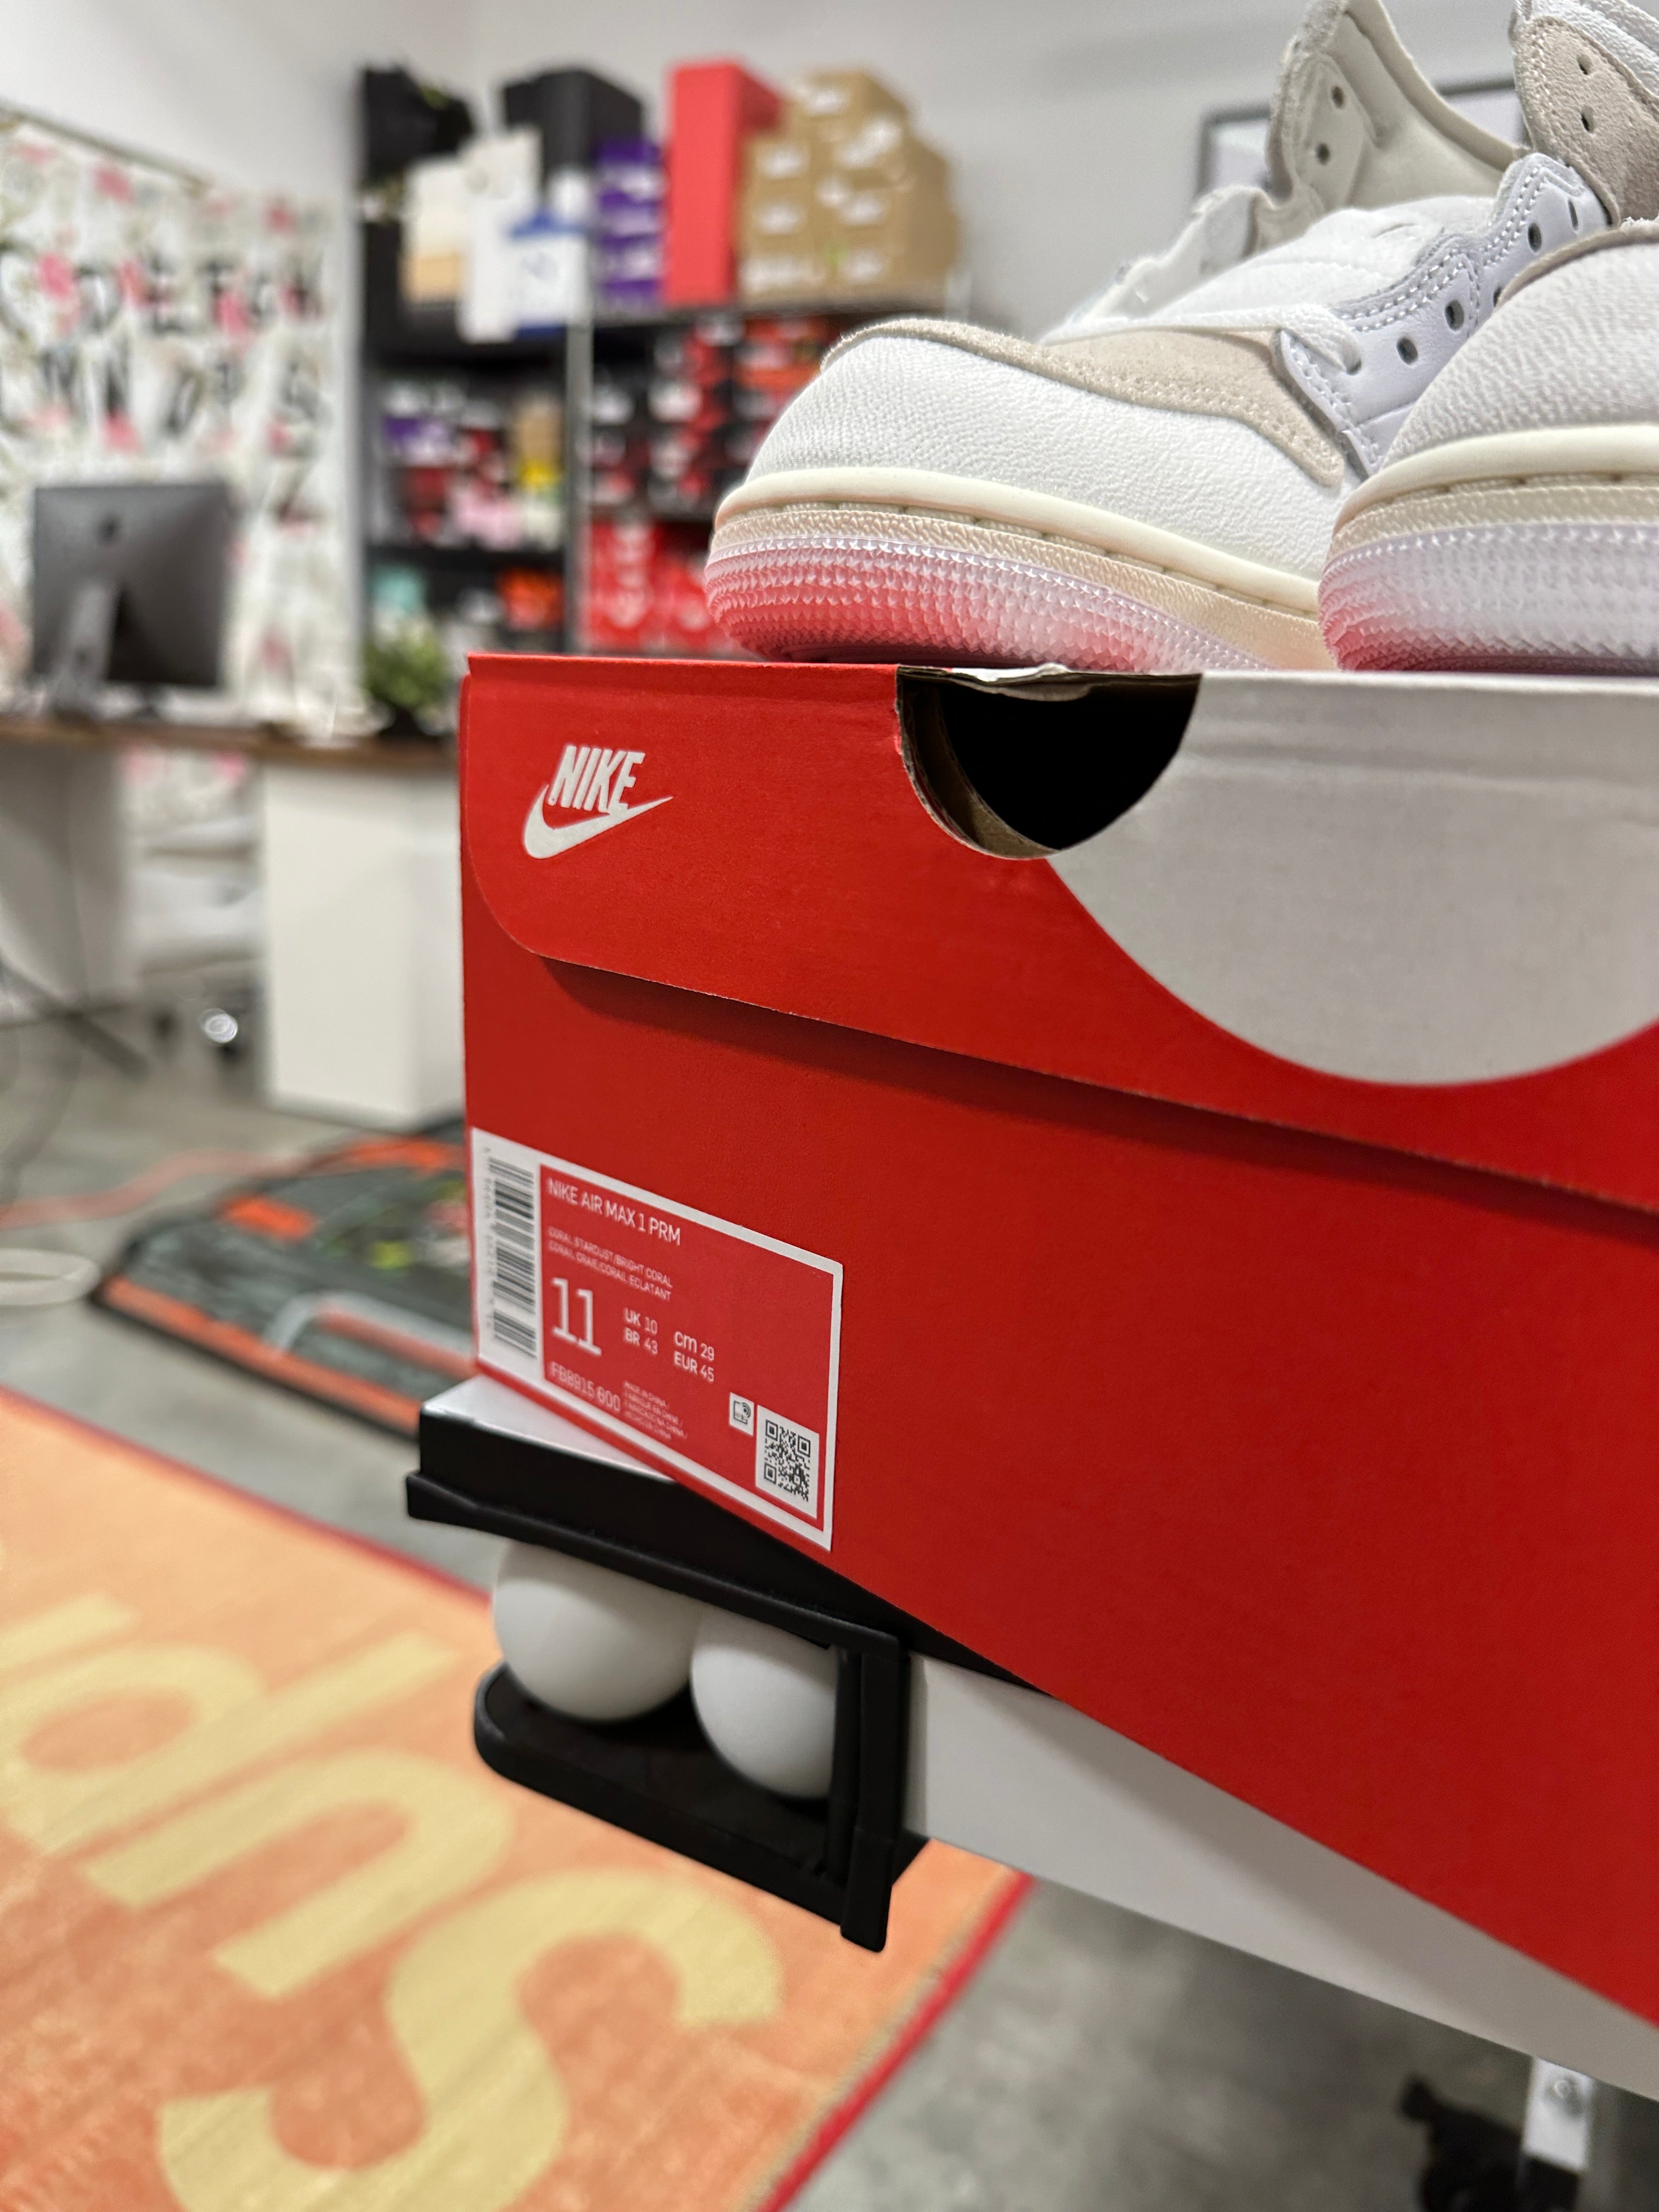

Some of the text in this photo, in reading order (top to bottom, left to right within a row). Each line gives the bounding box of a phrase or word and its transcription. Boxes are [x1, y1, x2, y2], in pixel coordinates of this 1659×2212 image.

[548, 744, 646, 814] NIKE
[548, 1178, 681, 1246] NIKE AIR MAX 1 PRM
[645, 1267, 674, 1289] CORAL
[551, 1277, 602, 1356] 11
[623, 1307, 658, 1336] UK 10
[623, 1327, 658, 1356] BR 43
[673, 1331, 715, 1362] cm 29
[673, 1350, 714, 1383] EUR 45
